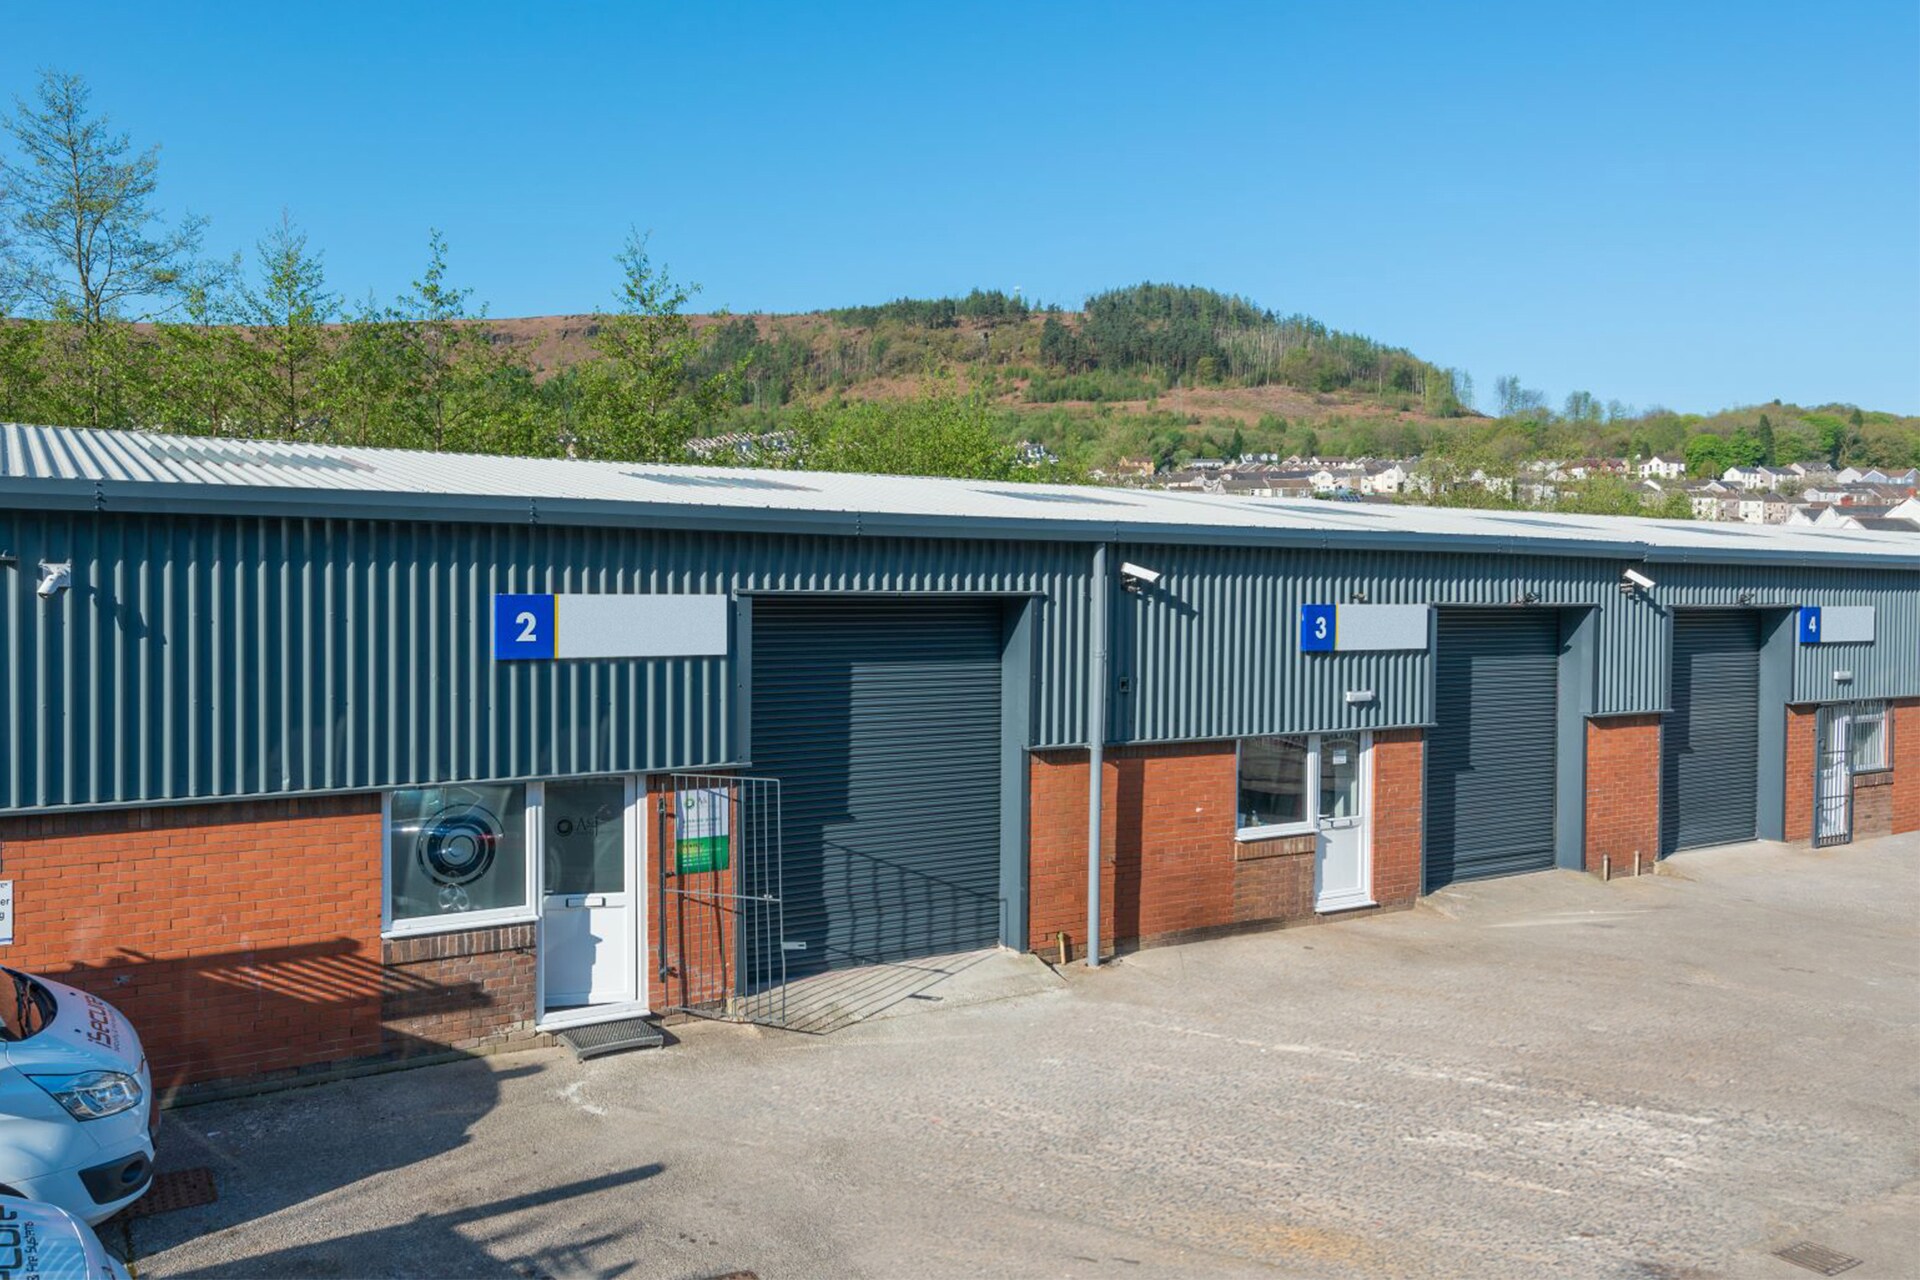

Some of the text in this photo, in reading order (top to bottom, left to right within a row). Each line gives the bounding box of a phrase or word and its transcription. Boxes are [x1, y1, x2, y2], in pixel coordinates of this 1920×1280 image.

[515, 611, 537, 642] 2
[1315, 616, 1327, 639] 3
[1808, 616, 1817, 633] 4
